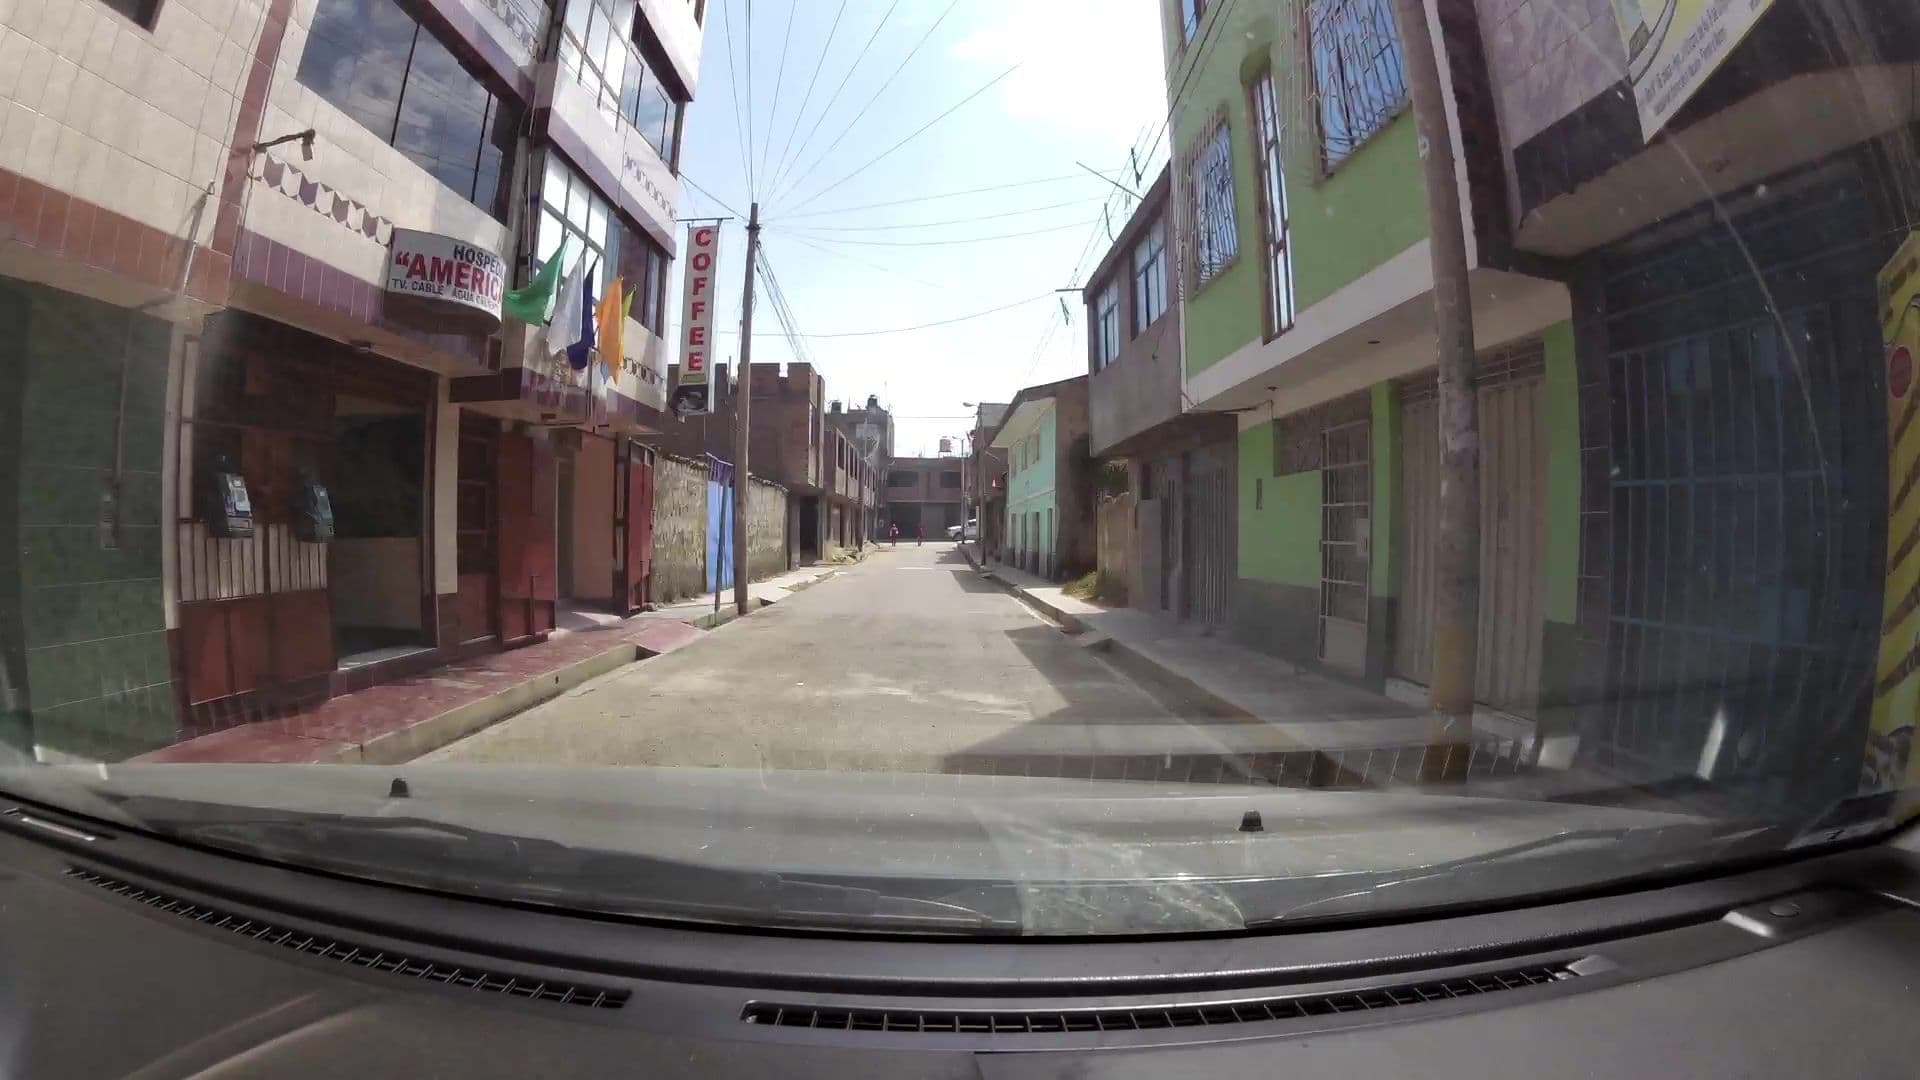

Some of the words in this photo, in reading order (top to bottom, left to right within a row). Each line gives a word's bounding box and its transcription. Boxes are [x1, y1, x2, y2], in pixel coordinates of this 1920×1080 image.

[453, 244, 504, 277] HOSPED
[411, 281, 444, 296] CABLE
[687, 228, 712, 372] COFFEE
